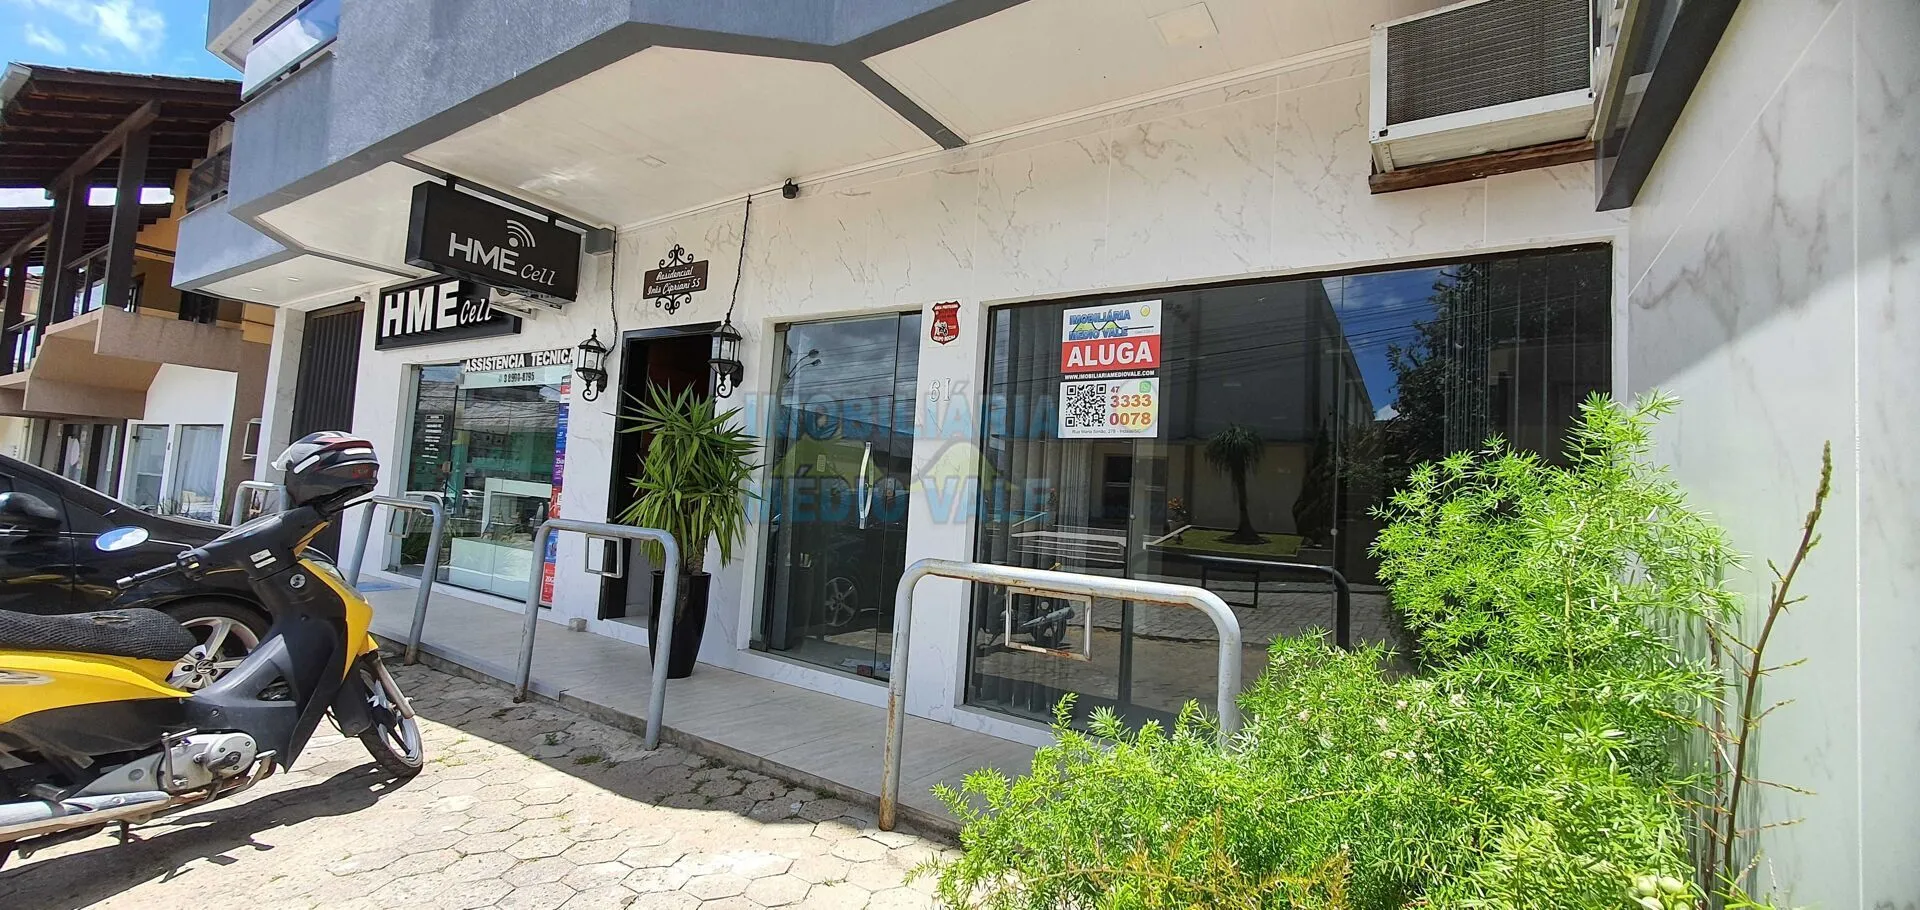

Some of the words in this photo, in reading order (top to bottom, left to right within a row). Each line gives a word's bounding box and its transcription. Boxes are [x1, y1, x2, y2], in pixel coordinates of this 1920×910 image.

[449, 232, 519, 276] HME
[521, 264, 556, 286] Cell
[656, 266, 694, 281] Residencial
[691, 278, 701, 288] 55
[382, 280, 459, 337] HME
[460, 299, 492, 325] Cell
[1102, 326, 1128, 339] VALE
[465, 353, 525, 372] ASSISTENCIA
[531, 349, 574, 367] TECNICA
[1067, 341, 1153, 367] ALUGA
[1064, 370, 1155, 380] WWW.IMOBILIARIAMEDIOVALE.COM
[929, 376, 951, 402] 61
[1110, 394, 1152, 408] 3333
[1109, 412, 1152, 425] 0078
